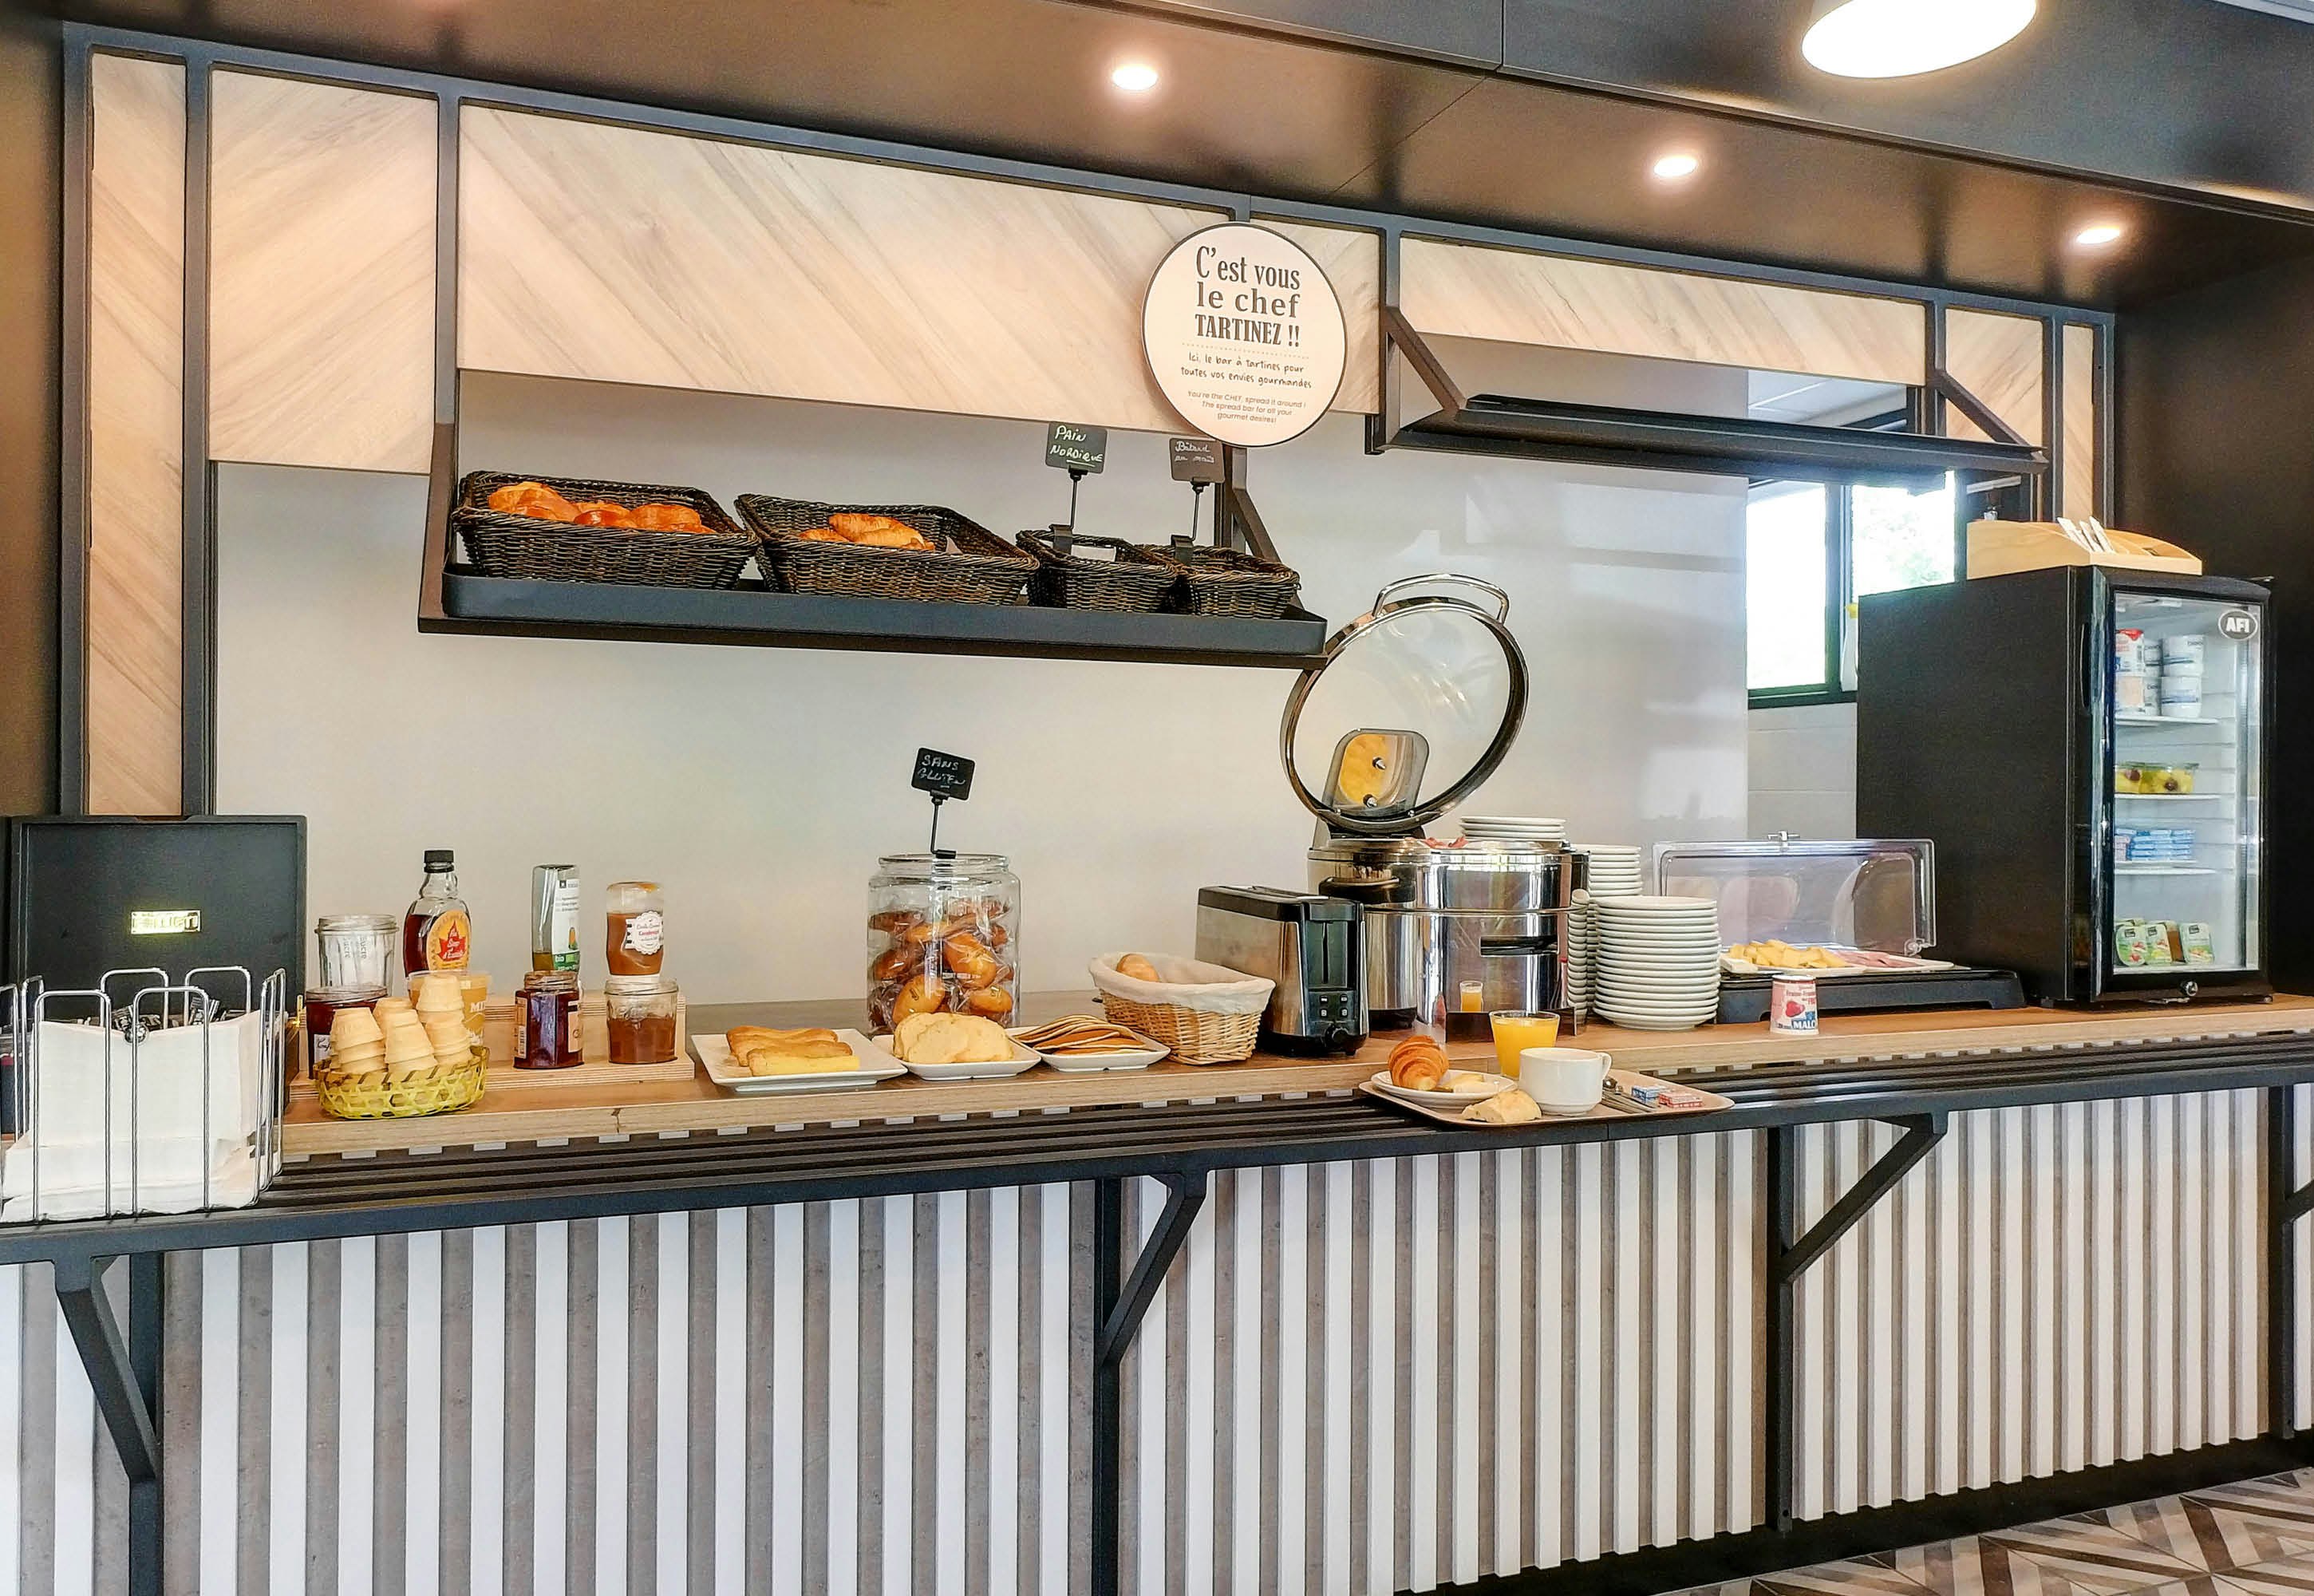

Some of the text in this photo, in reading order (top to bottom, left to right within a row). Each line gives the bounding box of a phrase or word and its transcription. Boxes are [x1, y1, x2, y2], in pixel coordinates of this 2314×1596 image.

[1196, 246, 1301, 290] C'est vous
[1197, 281, 1301, 318] le chef
[1195, 314, 1300, 347] TARTINEZ !!
[1205, 354, 1212, 364] le
[1216, 355, 1232, 365] bar
[1236, 356, 1242, 366] à
[1246, 359, 1281, 371] tartines
[1284, 365, 1305, 375] pour
[1181, 367, 1313, 389] toutes vos envies gourmandes
[1216, 401, 1241, 412] spread
[1277, 399, 1302, 409] around
[2226, 617, 2250, 633] AFI
[922, 754, 959, 771] SANS
